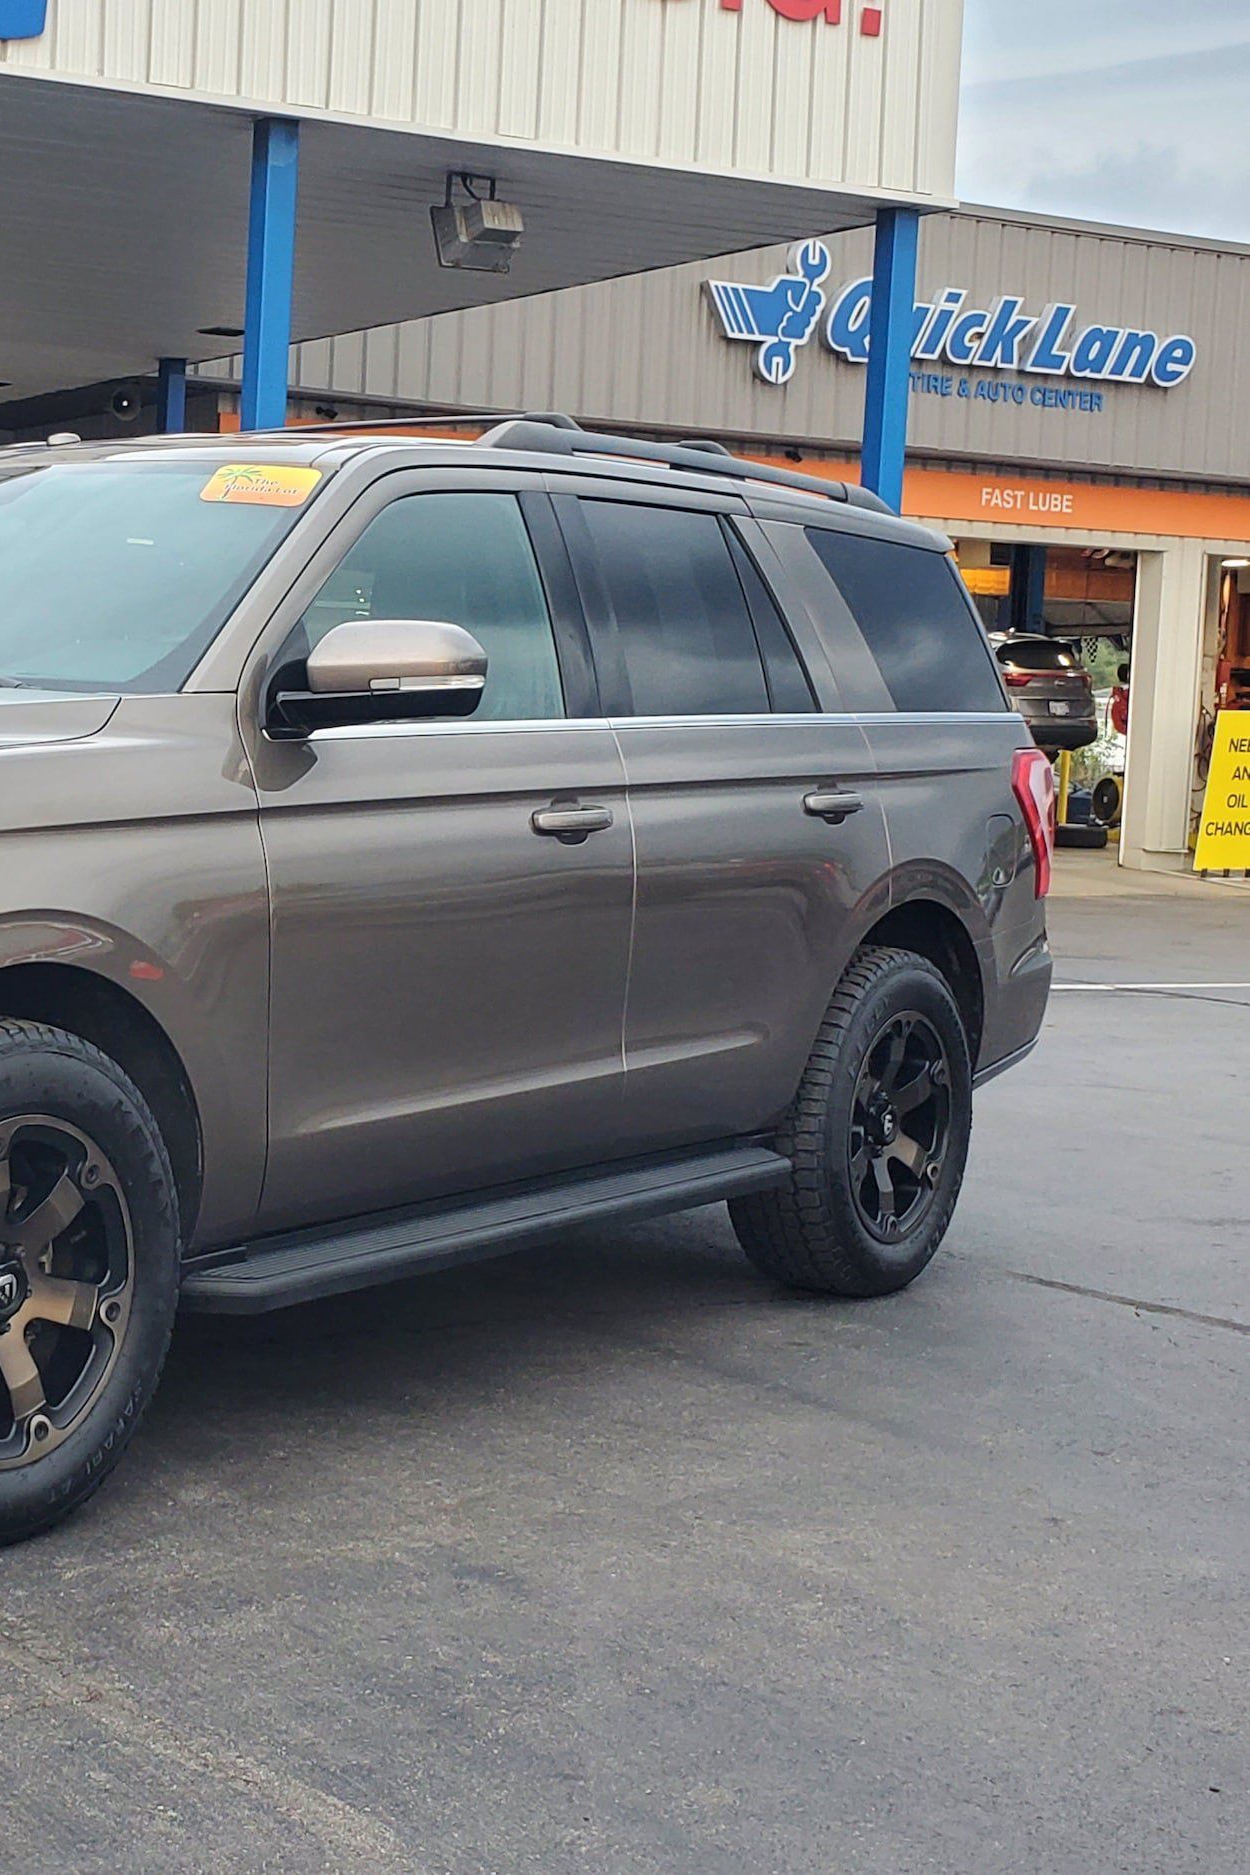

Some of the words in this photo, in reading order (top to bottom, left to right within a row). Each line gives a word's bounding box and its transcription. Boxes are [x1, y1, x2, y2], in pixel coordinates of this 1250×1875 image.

[1022, 303, 1197, 388] Lane
[909, 372, 953, 398] TIRE
[957, 377, 971, 399] &
[974, 380, 1028, 405] AUTO
[1029, 384, 1104, 413] CENTER
[981, 487, 1026, 509] FAST
[1029, 491, 1074, 514] LUBE
[1226, 793, 1249, 809] OIL
